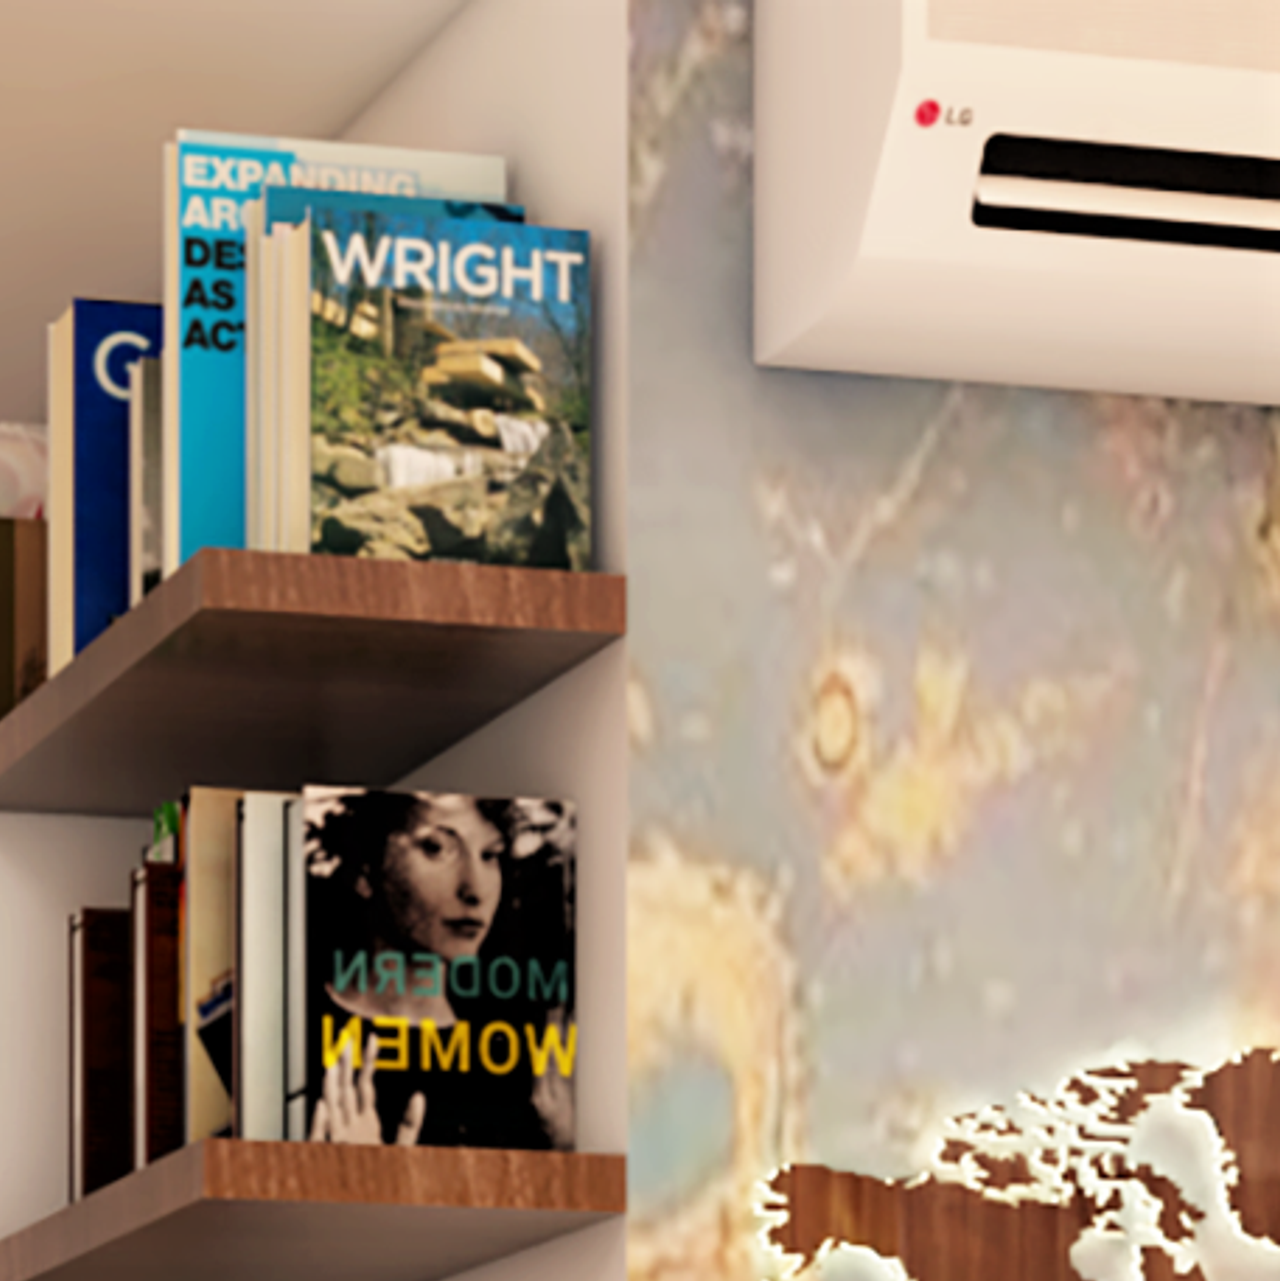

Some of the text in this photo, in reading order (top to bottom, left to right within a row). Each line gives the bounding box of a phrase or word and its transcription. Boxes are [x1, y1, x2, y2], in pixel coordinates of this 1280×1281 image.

[945, 105, 973, 126] LG
[182, 154, 418, 198] EXPANDING
[182, 196, 248, 230] AR
[184, 237, 246, 270] DE
[322, 230, 584, 303] WRIGHT
[183, 278, 235, 310] AS
[183, 320, 246, 352] AC
